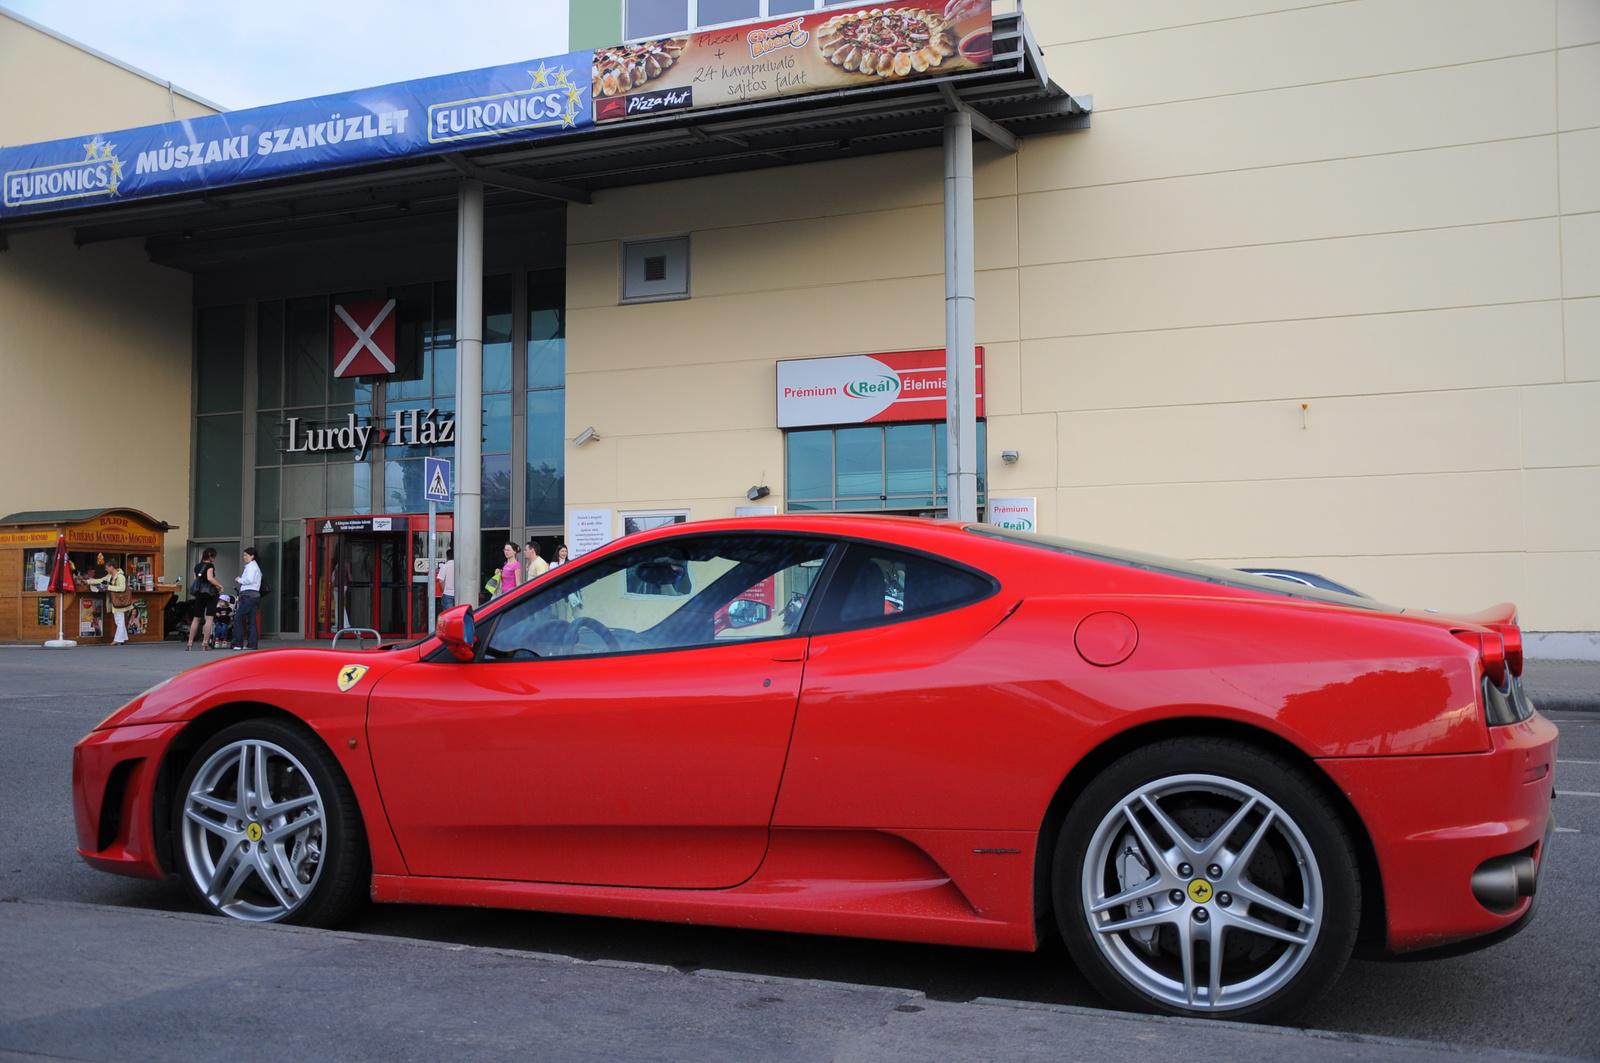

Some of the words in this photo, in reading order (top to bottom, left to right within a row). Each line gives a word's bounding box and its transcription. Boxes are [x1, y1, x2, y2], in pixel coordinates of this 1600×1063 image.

[695, 33, 739, 47] Pizza
[752, 34, 791, 57] Bites
[693, 66, 717, 83] 24
[721, 55, 795, 80] harapnivaló
[727, 80, 767, 100] sajtos
[775, 71, 807, 92] falat
[436, 93, 562, 134] EURONICS
[627, 97, 662, 113] Pizza
[663, 92, 690, 106] Hut
[135, 135, 249, 175] MŰSZAKI
[257, 109, 409, 155] SZAKÜZLET
[11, 165, 108, 199] EURONICS
[784, 386, 837, 398] Prémium
[859, 380, 890, 393] Reál
[286, 413, 373, 461] Lurdy
[392, 408, 455, 446] Ház
[994, 505, 1029, 513] Prémium
[100, 517, 129, 528] BAJOR
[1003, 521, 1025, 530] Reál
